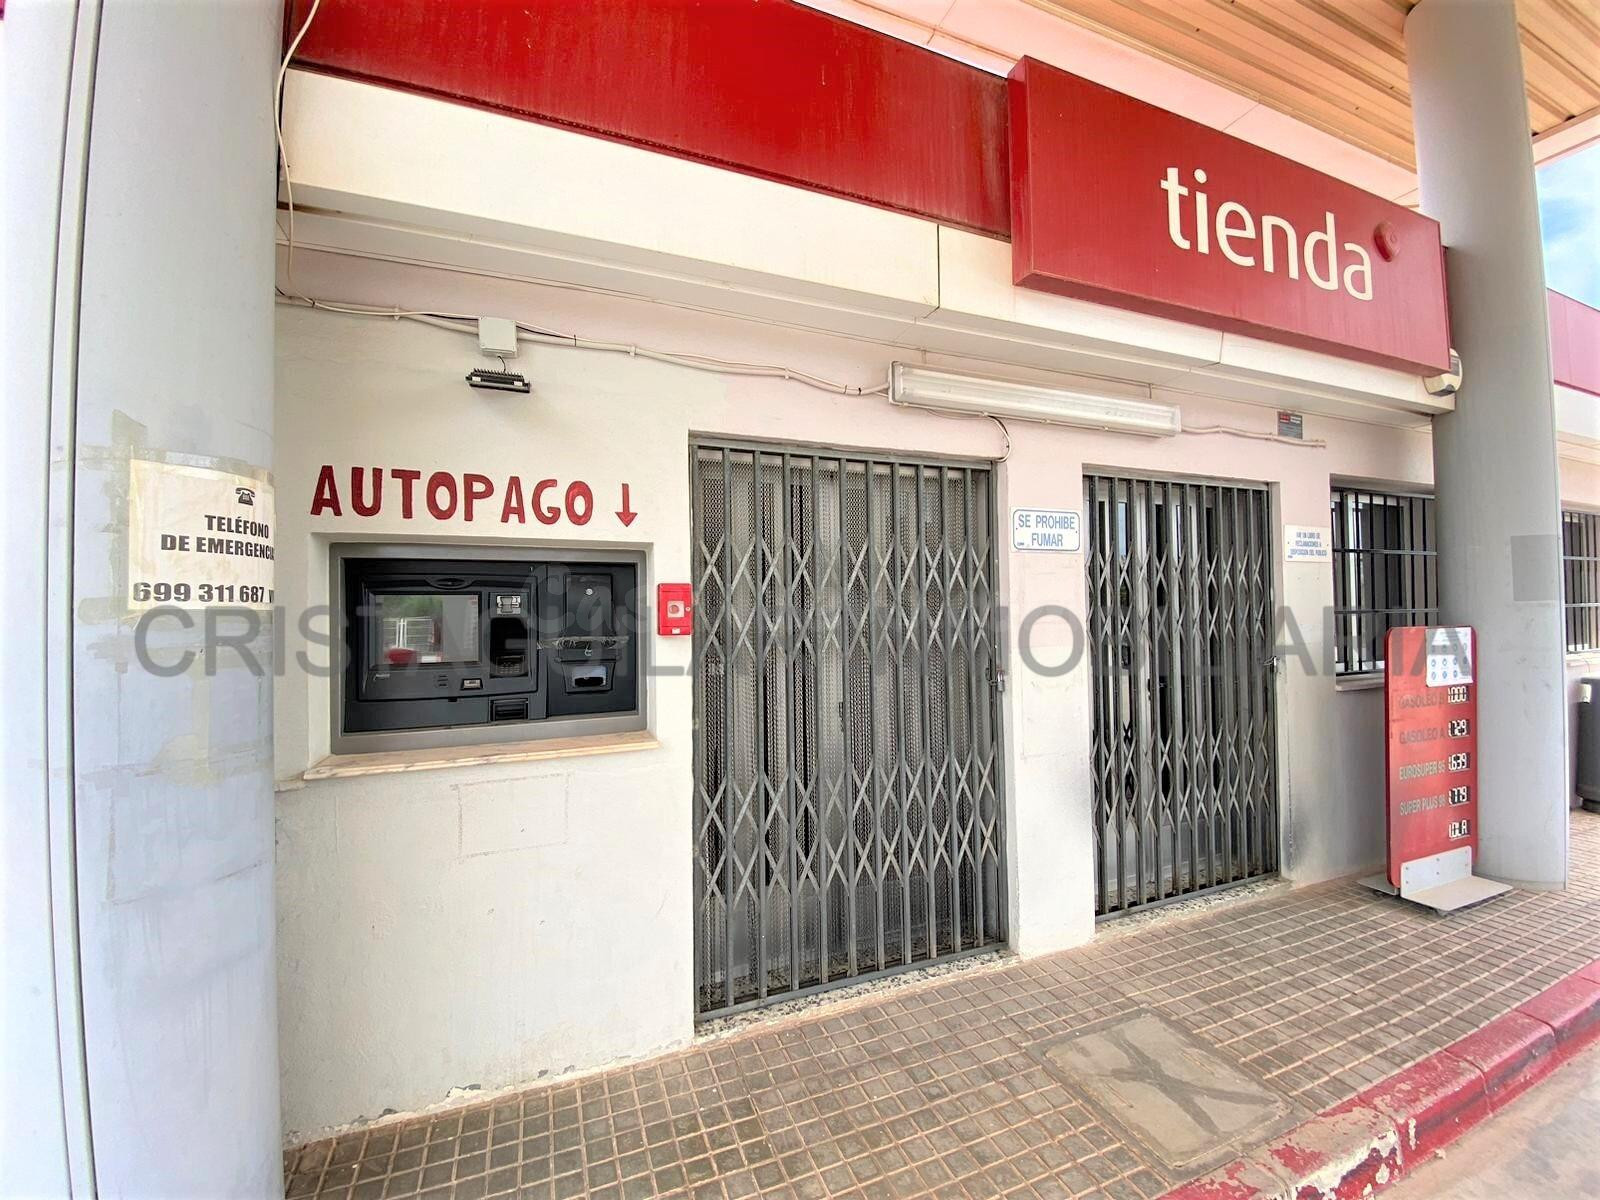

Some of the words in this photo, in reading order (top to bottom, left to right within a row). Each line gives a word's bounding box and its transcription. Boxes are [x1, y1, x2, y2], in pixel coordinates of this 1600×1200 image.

[1160, 167, 1373, 301] tienda
[310, 465, 593, 526] AUTOPAGO
[205, 514, 269, 539] TELÉFONO
[1018, 514, 1031, 528] SE
[1035, 515, 1076, 530] PROHIBE
[161, 534, 190, 552] DE
[1031, 532, 1064, 547] FUMAR
[133, 582, 191, 602] 699
[198, 584, 234, 602] 311
[239, 585, 265, 603] 687
[1400, 798, 1421, 816] SUPER
